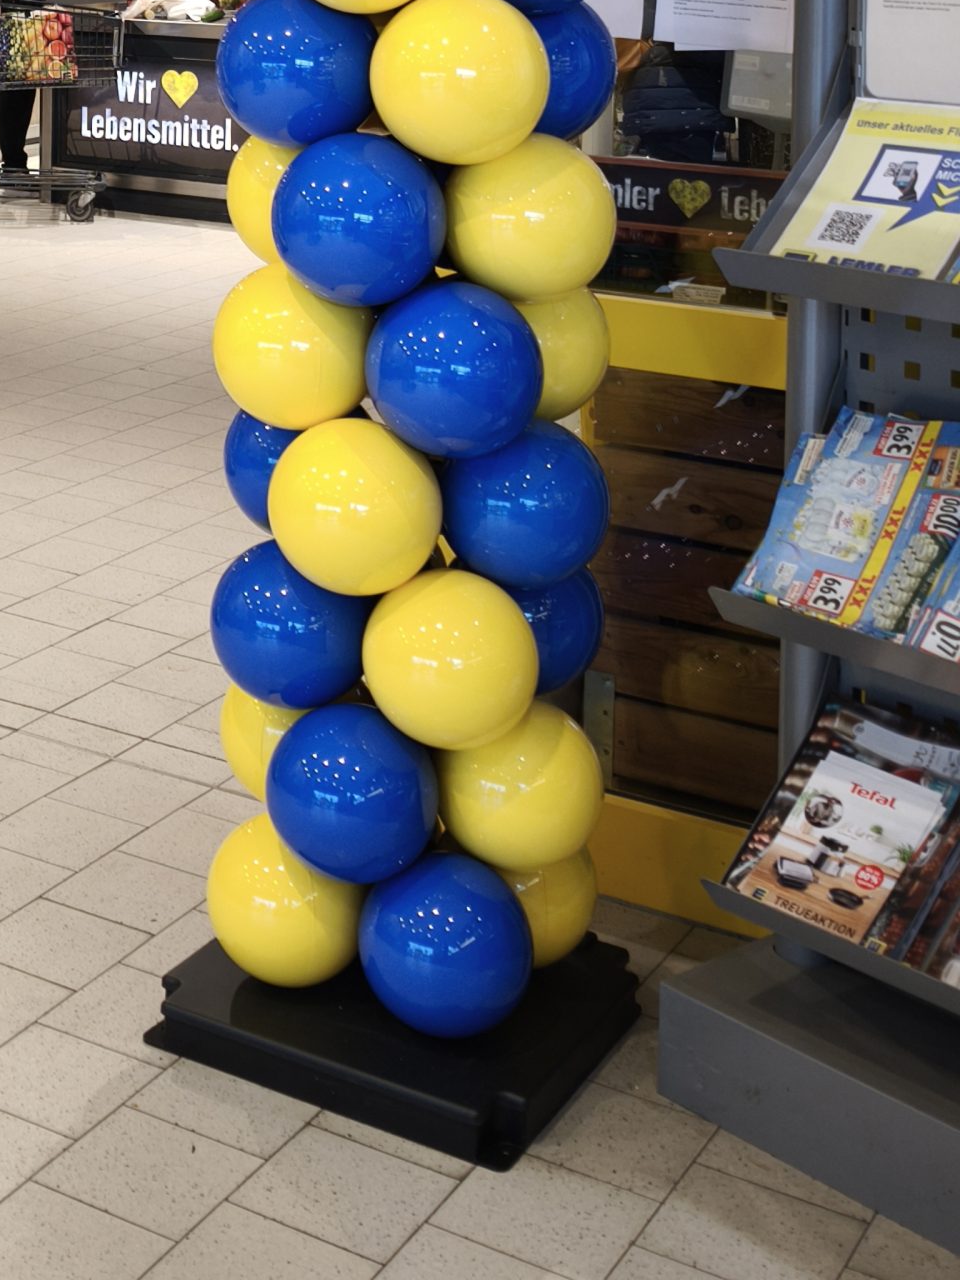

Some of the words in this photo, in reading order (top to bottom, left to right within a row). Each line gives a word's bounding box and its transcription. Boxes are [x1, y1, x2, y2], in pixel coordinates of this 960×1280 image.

[116, 70, 157, 104] Wir
[81, 106, 239, 152] Lebensmittel.
[892, 122, 944, 136] aktuelles
[886, 425, 916, 456] 3.99
[910, 438, 934, 473] XXL
[881, 506, 906, 541] XXL
[813, 577, 843, 611] 3.99
[849, 575, 877, 609] XXL
[848, 781, 897, 810] Tefal
[773, 895, 857, 939] TREUEAKTION
